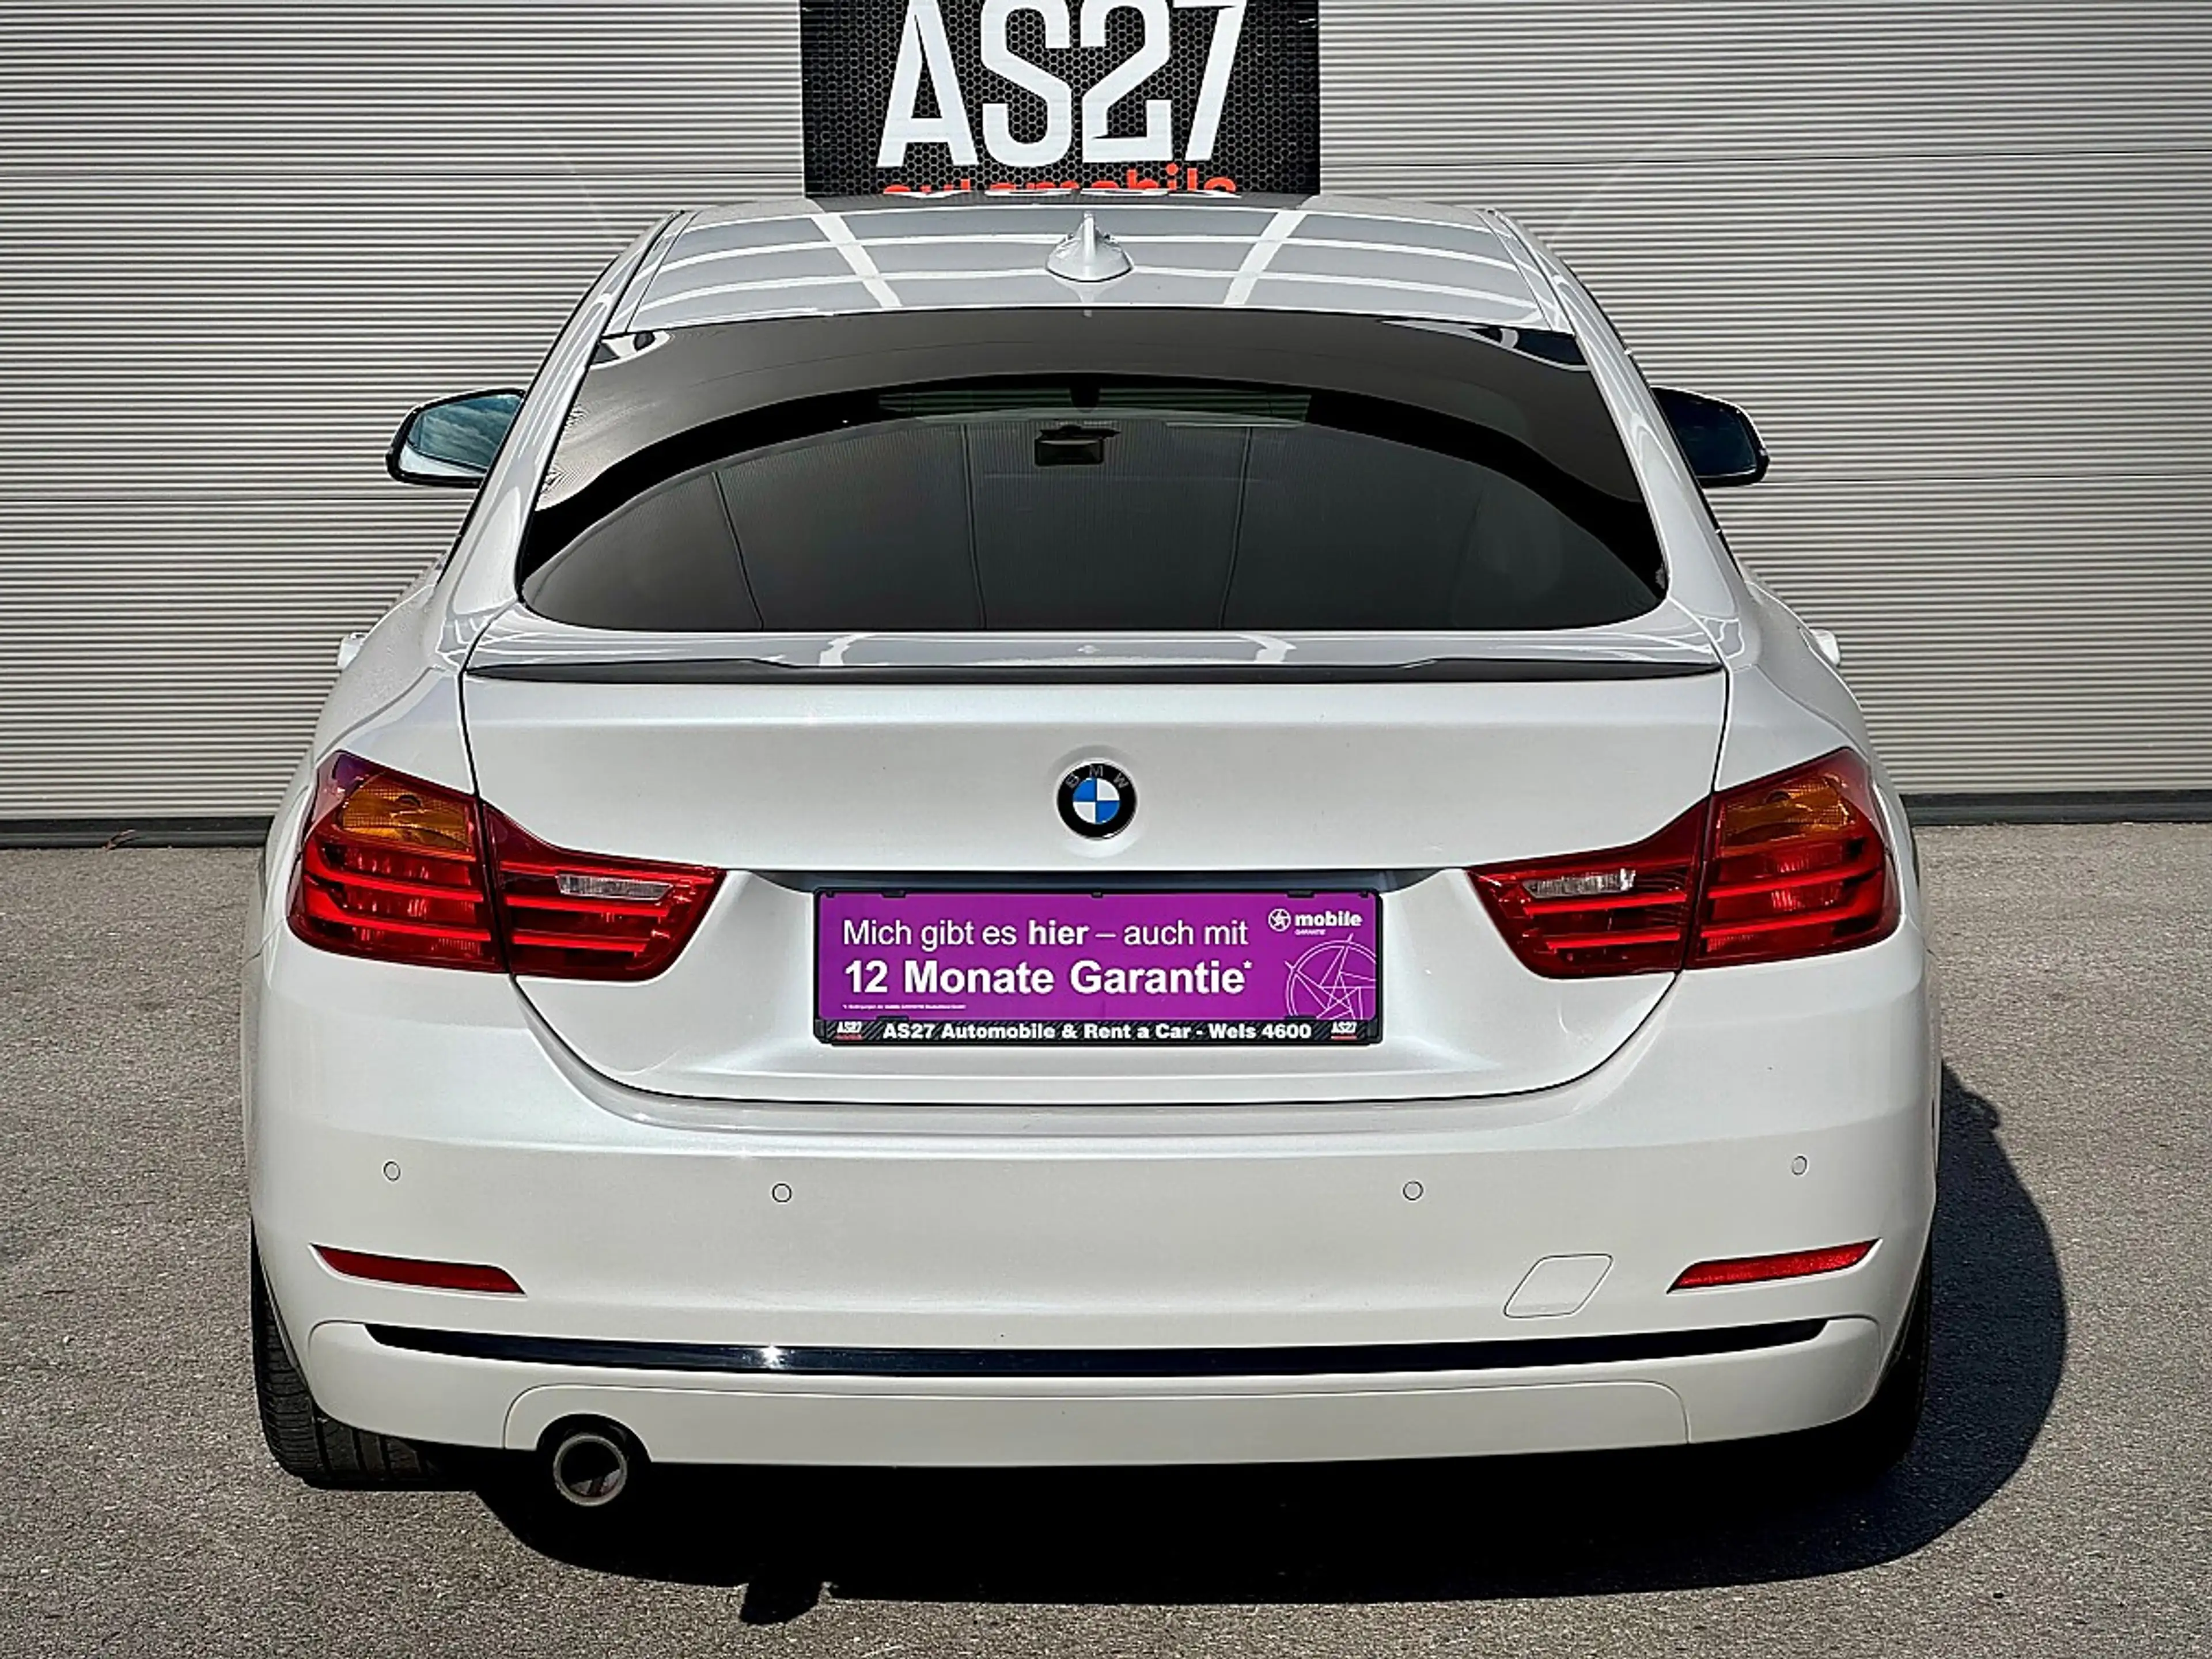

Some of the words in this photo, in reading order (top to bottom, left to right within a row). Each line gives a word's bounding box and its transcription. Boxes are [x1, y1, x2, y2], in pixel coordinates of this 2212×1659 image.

[876, 0, 1247, 168] AS27
[1065, 764, 1129, 789] BMW
[1295, 911, 1363, 926] mobile
[844, 919, 912, 945] Mich
[921, 919, 975, 952] gibt
[982, 926, 1017, 945] es
[1028, 919, 1090, 945] hier
[1123, 919, 1194, 945] auch
[1204, 920, 1249, 945] mit
[845, 960, 888, 993] 12
[904, 960, 1055, 994] Monate
[882, 1023, 935, 1039] AS27
[941, 1023, 1055, 1039] Automobile
[1062, 1024, 1078, 1039] &
[1084, 1024, 1131, 1039] Rent
[1137, 1027, 1150, 1039] a
[1155, 1023, 1192, 1039] Car
[1208, 1023, 1256, 1039] Wels
[1262, 1024, 1312, 1039] 4600
